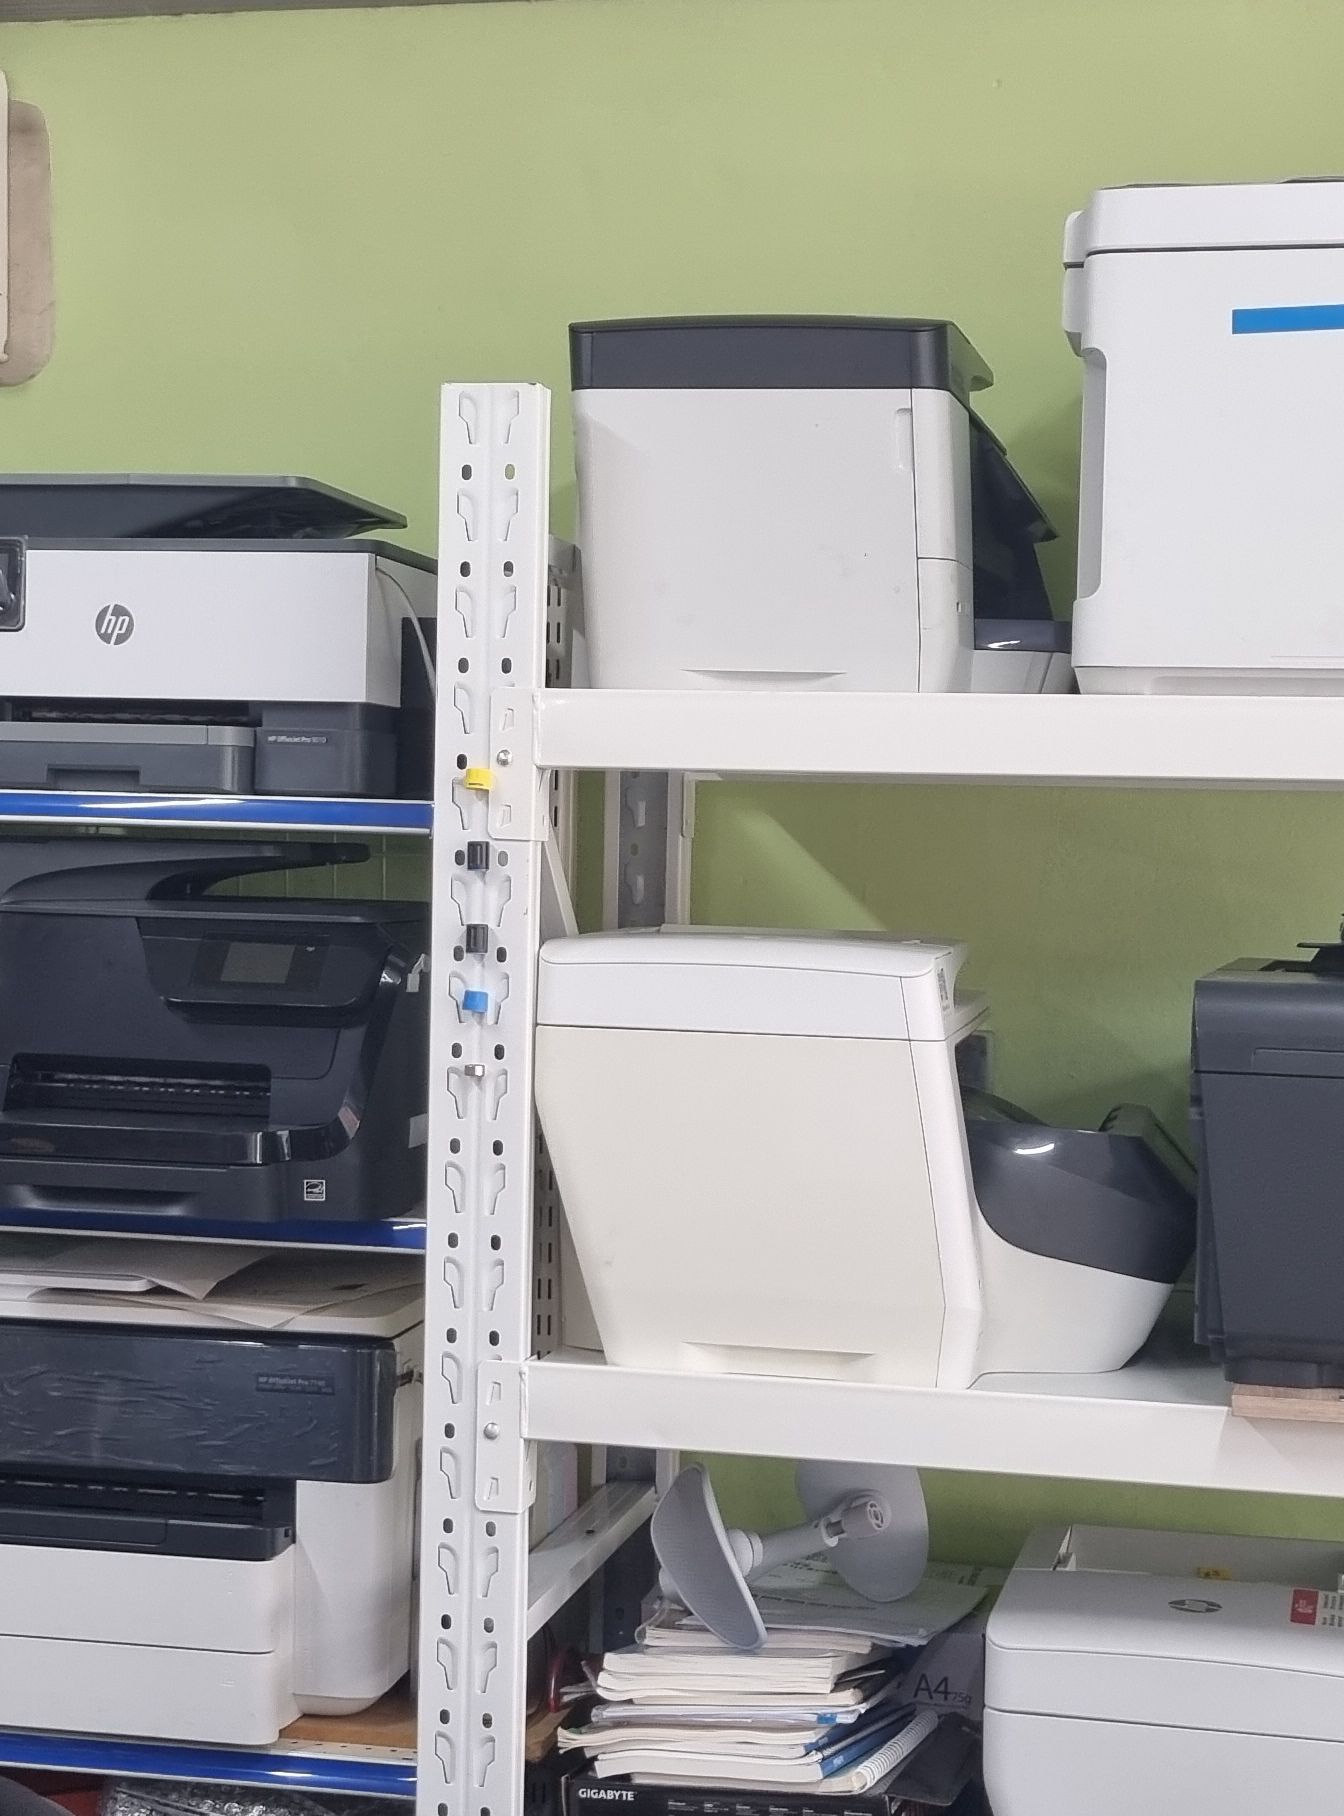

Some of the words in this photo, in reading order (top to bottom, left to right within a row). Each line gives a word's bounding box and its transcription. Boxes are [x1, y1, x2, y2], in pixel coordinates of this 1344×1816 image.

[101, 604, 129, 645] hp
[913, 1673, 951, 1701] A4
[578, 1788, 635, 1801] GIGABYTE
